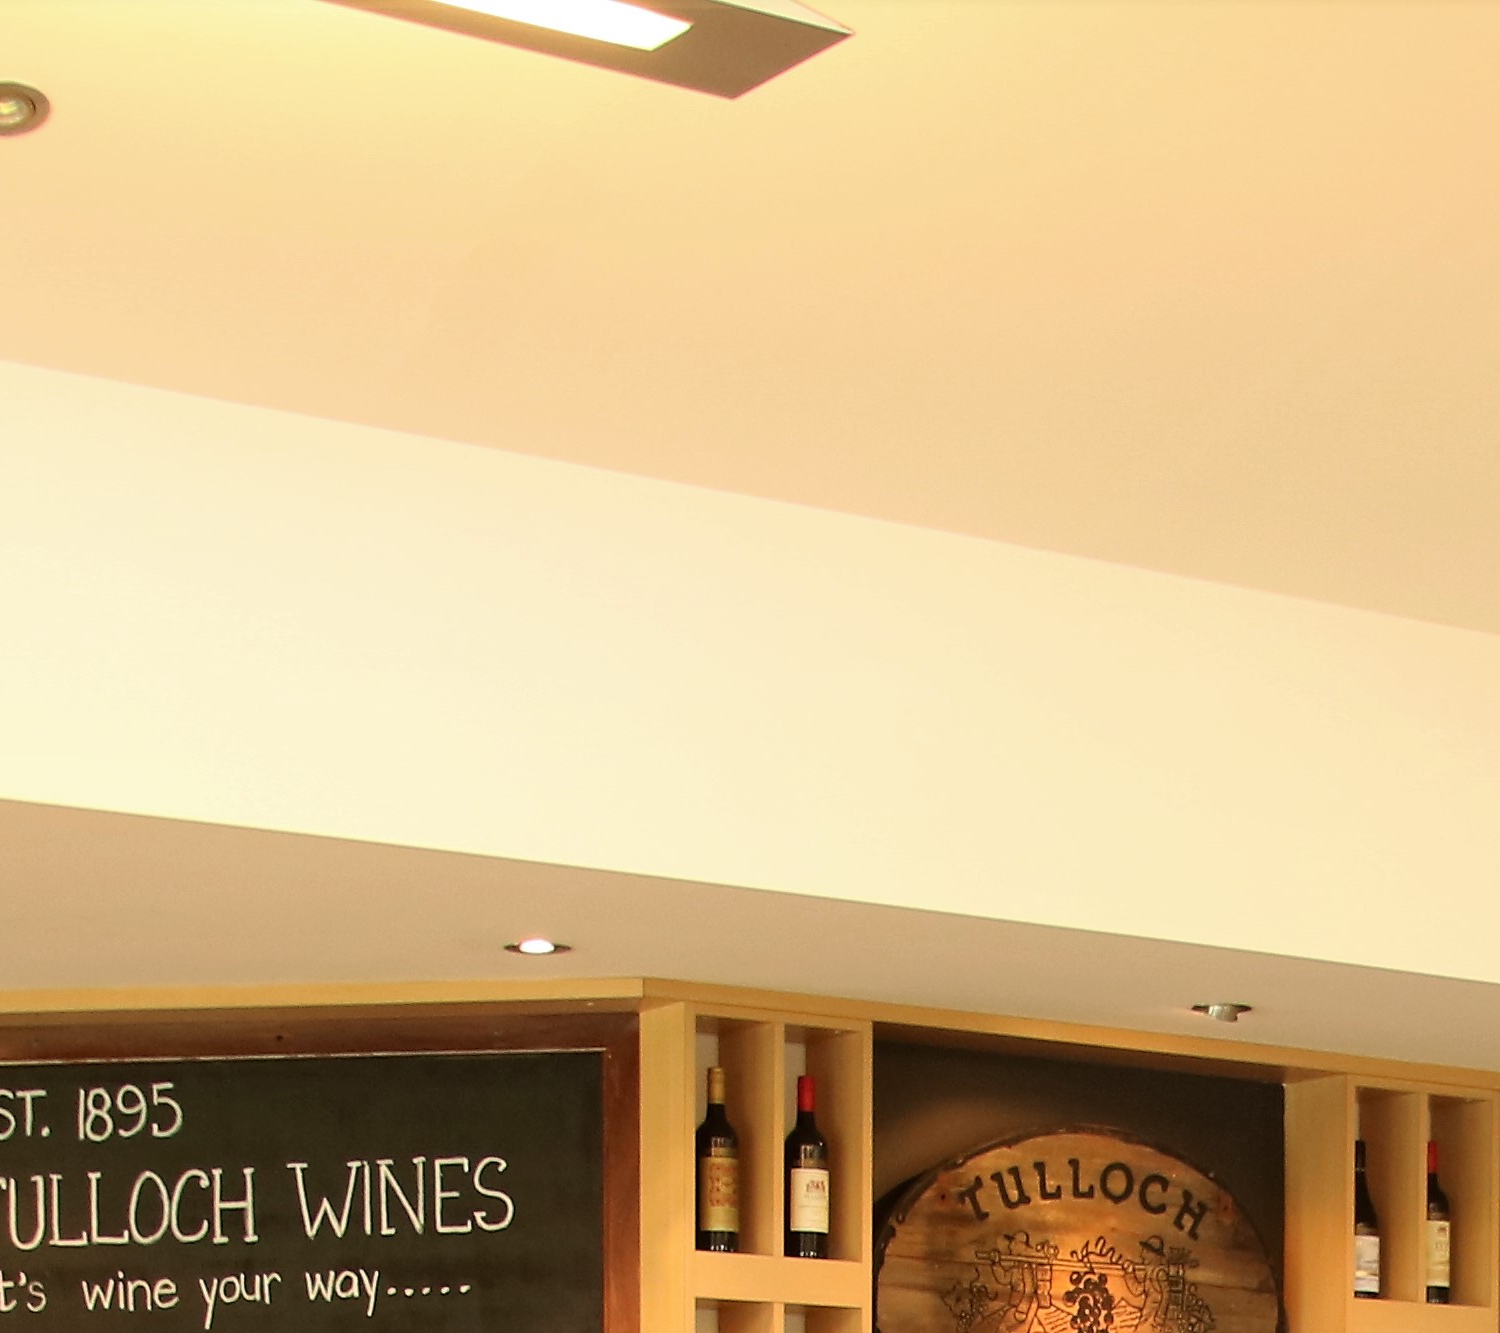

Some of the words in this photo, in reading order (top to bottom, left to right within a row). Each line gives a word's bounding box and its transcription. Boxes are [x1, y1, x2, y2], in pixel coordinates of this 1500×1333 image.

[77, 1081, 185, 1141] 1895
[287, 1156, 516, 1241] WINES
[956, 1158, 1214, 1241] TULLOCH
[82, 1269, 180, 1312] wine
[199, 1267, 282, 1329] your
